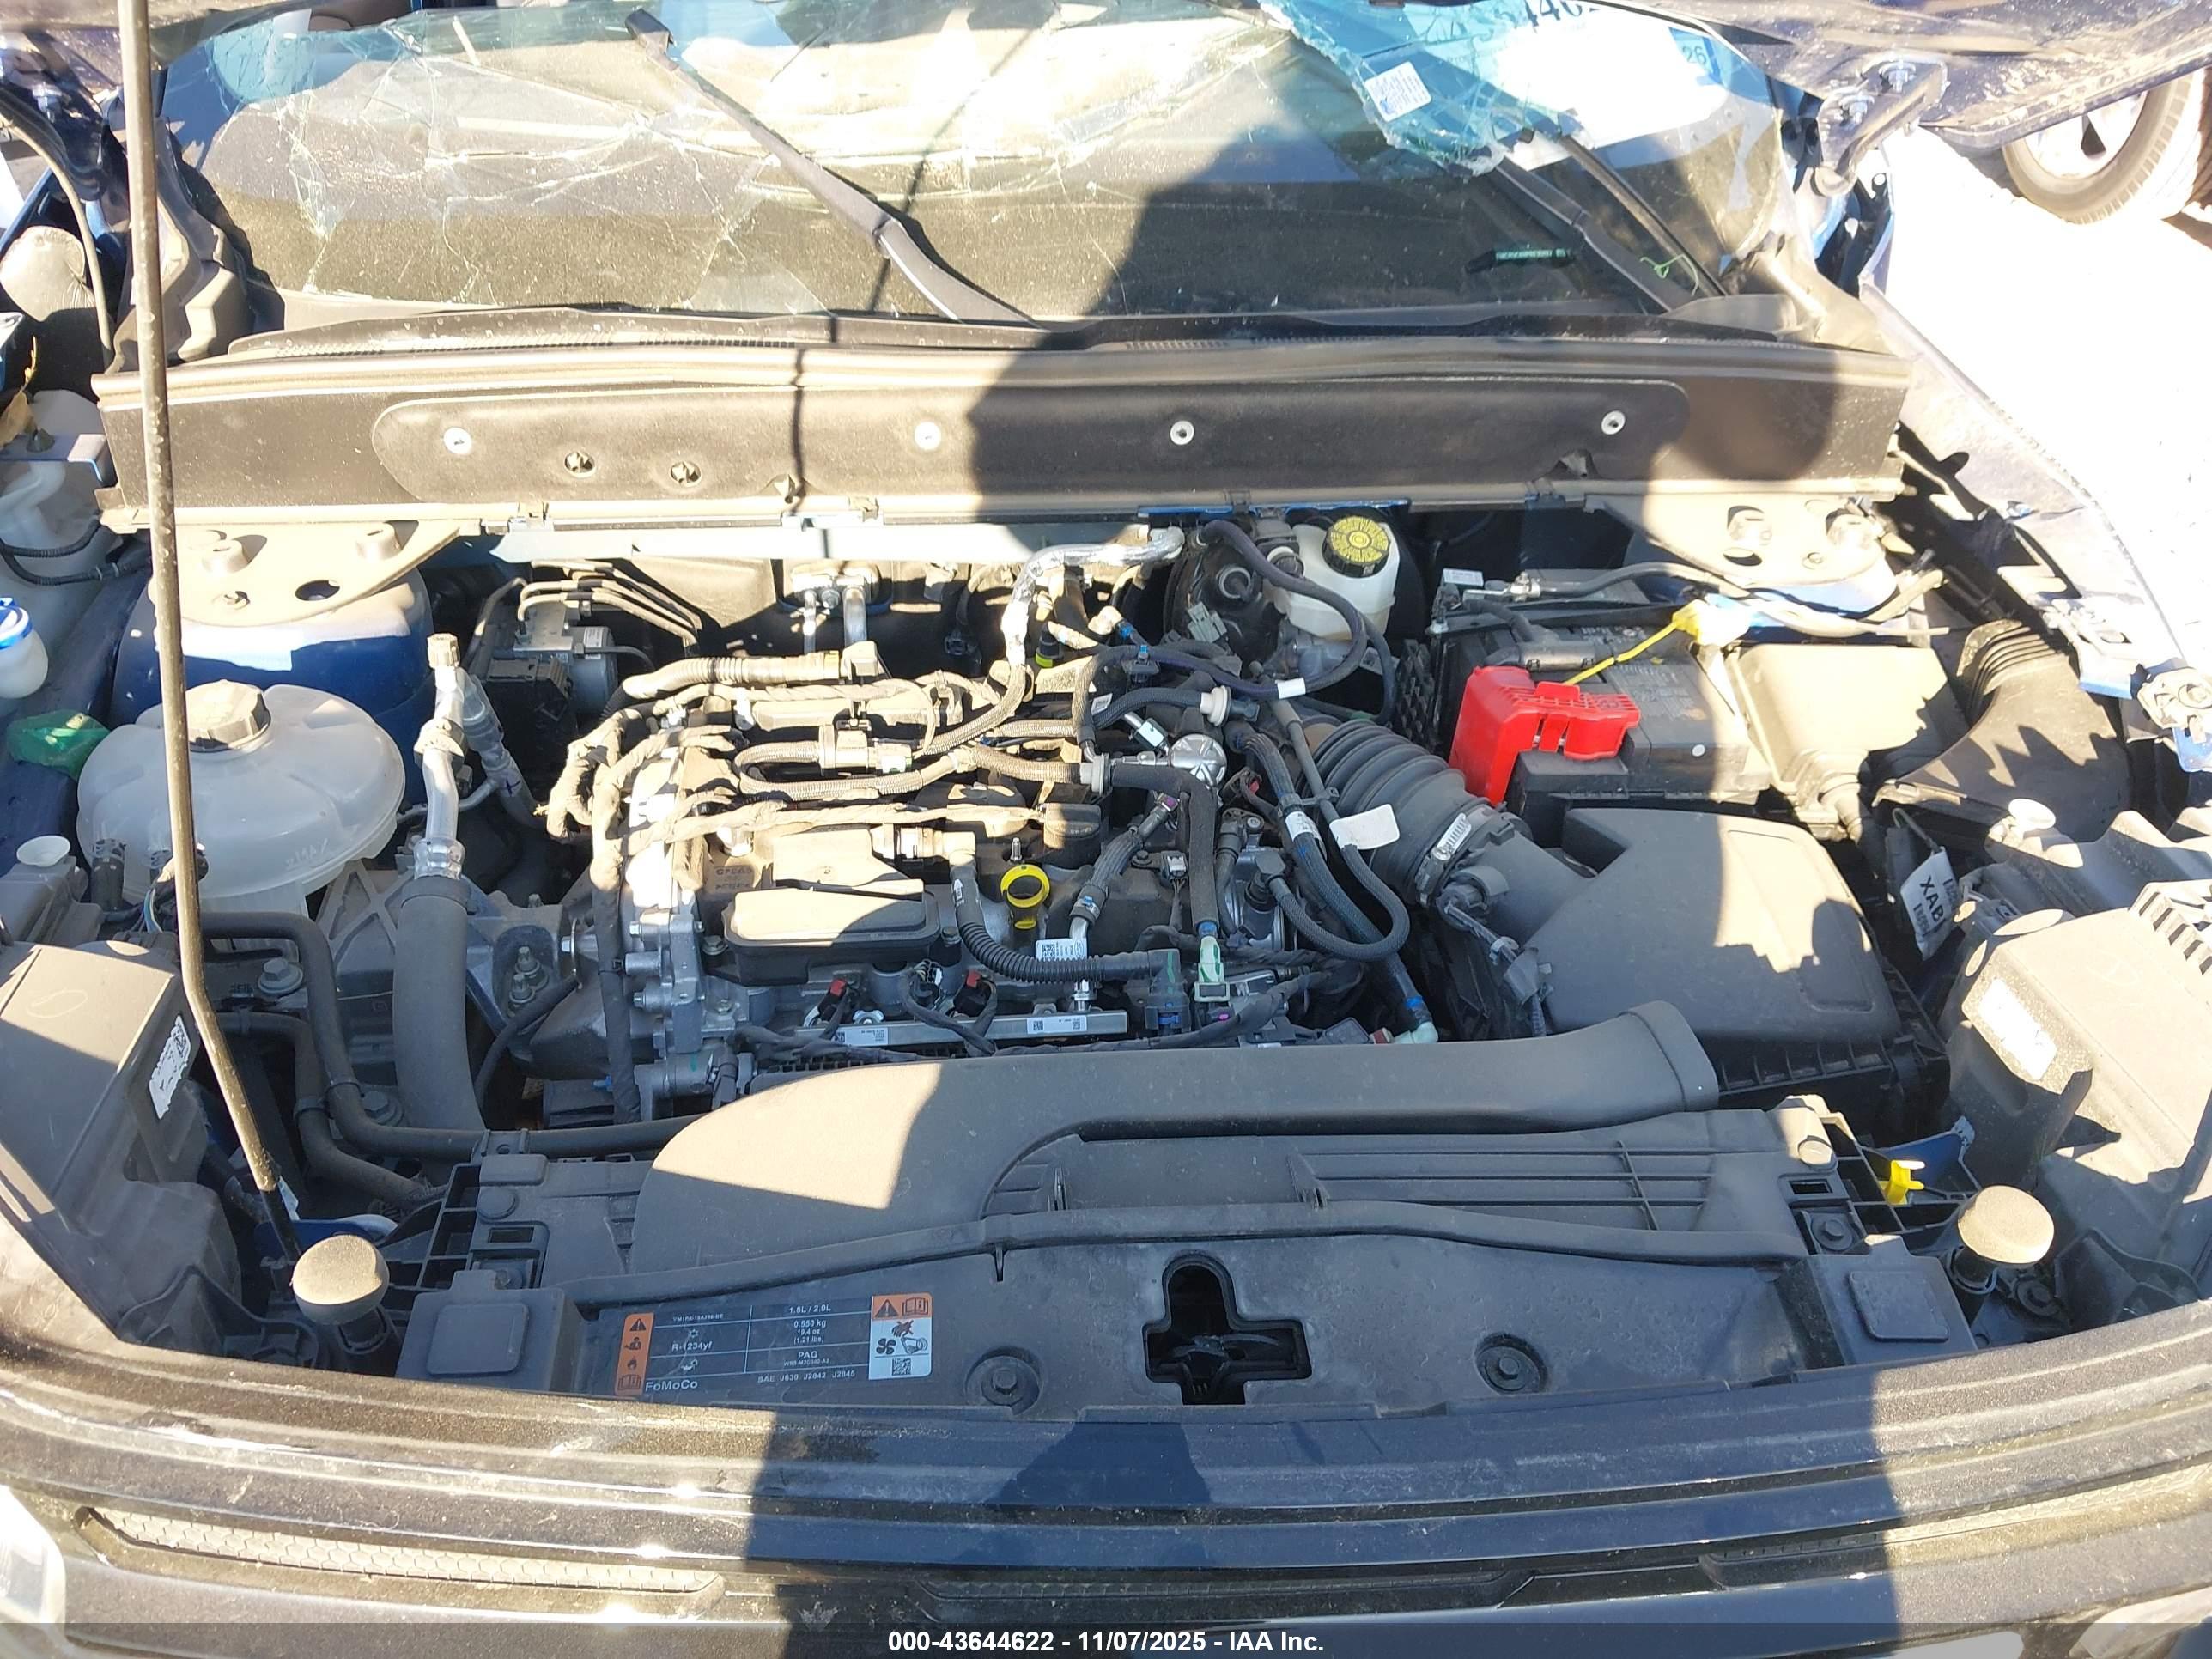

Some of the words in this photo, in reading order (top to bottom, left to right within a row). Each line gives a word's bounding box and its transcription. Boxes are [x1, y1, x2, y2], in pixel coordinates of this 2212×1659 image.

[812, 1304, 832, 1313] 2.0L
[817, 1319, 827, 1328] kg
[672, 1340, 713, 1352] R-1234yf
[798, 1350, 818, 1359] PAG
[645, 1379, 699, 1392] FoMoCo
